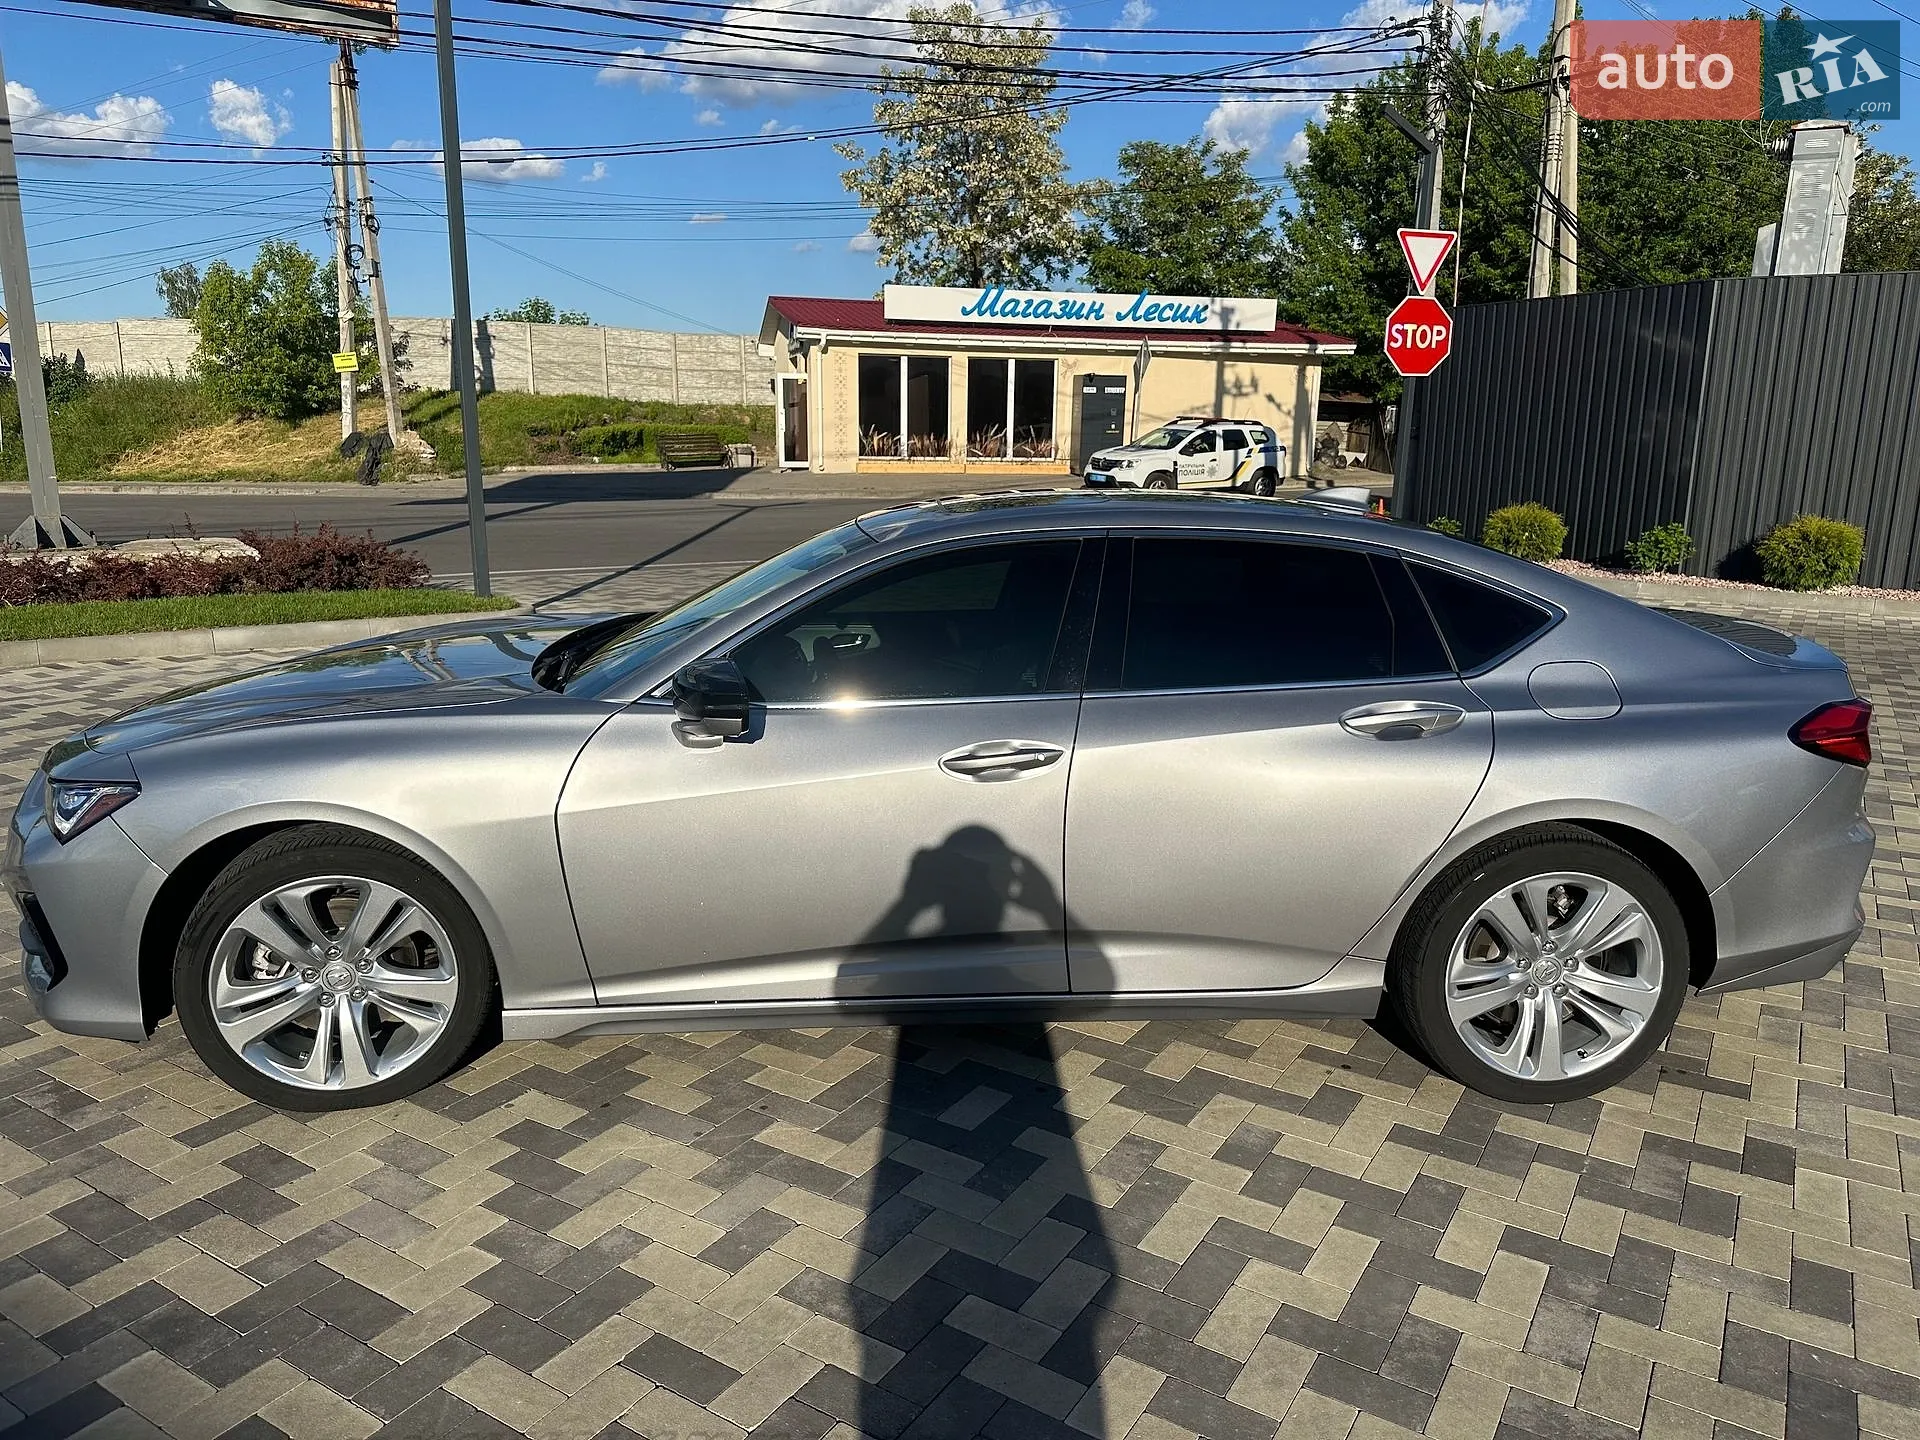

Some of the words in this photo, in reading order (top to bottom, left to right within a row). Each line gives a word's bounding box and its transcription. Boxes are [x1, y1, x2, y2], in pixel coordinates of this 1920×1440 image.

[961, 283, 1105, 321] Магазин
[1115, 287, 1209, 324] Лесик
[1389, 323, 1447, 349] STOP
